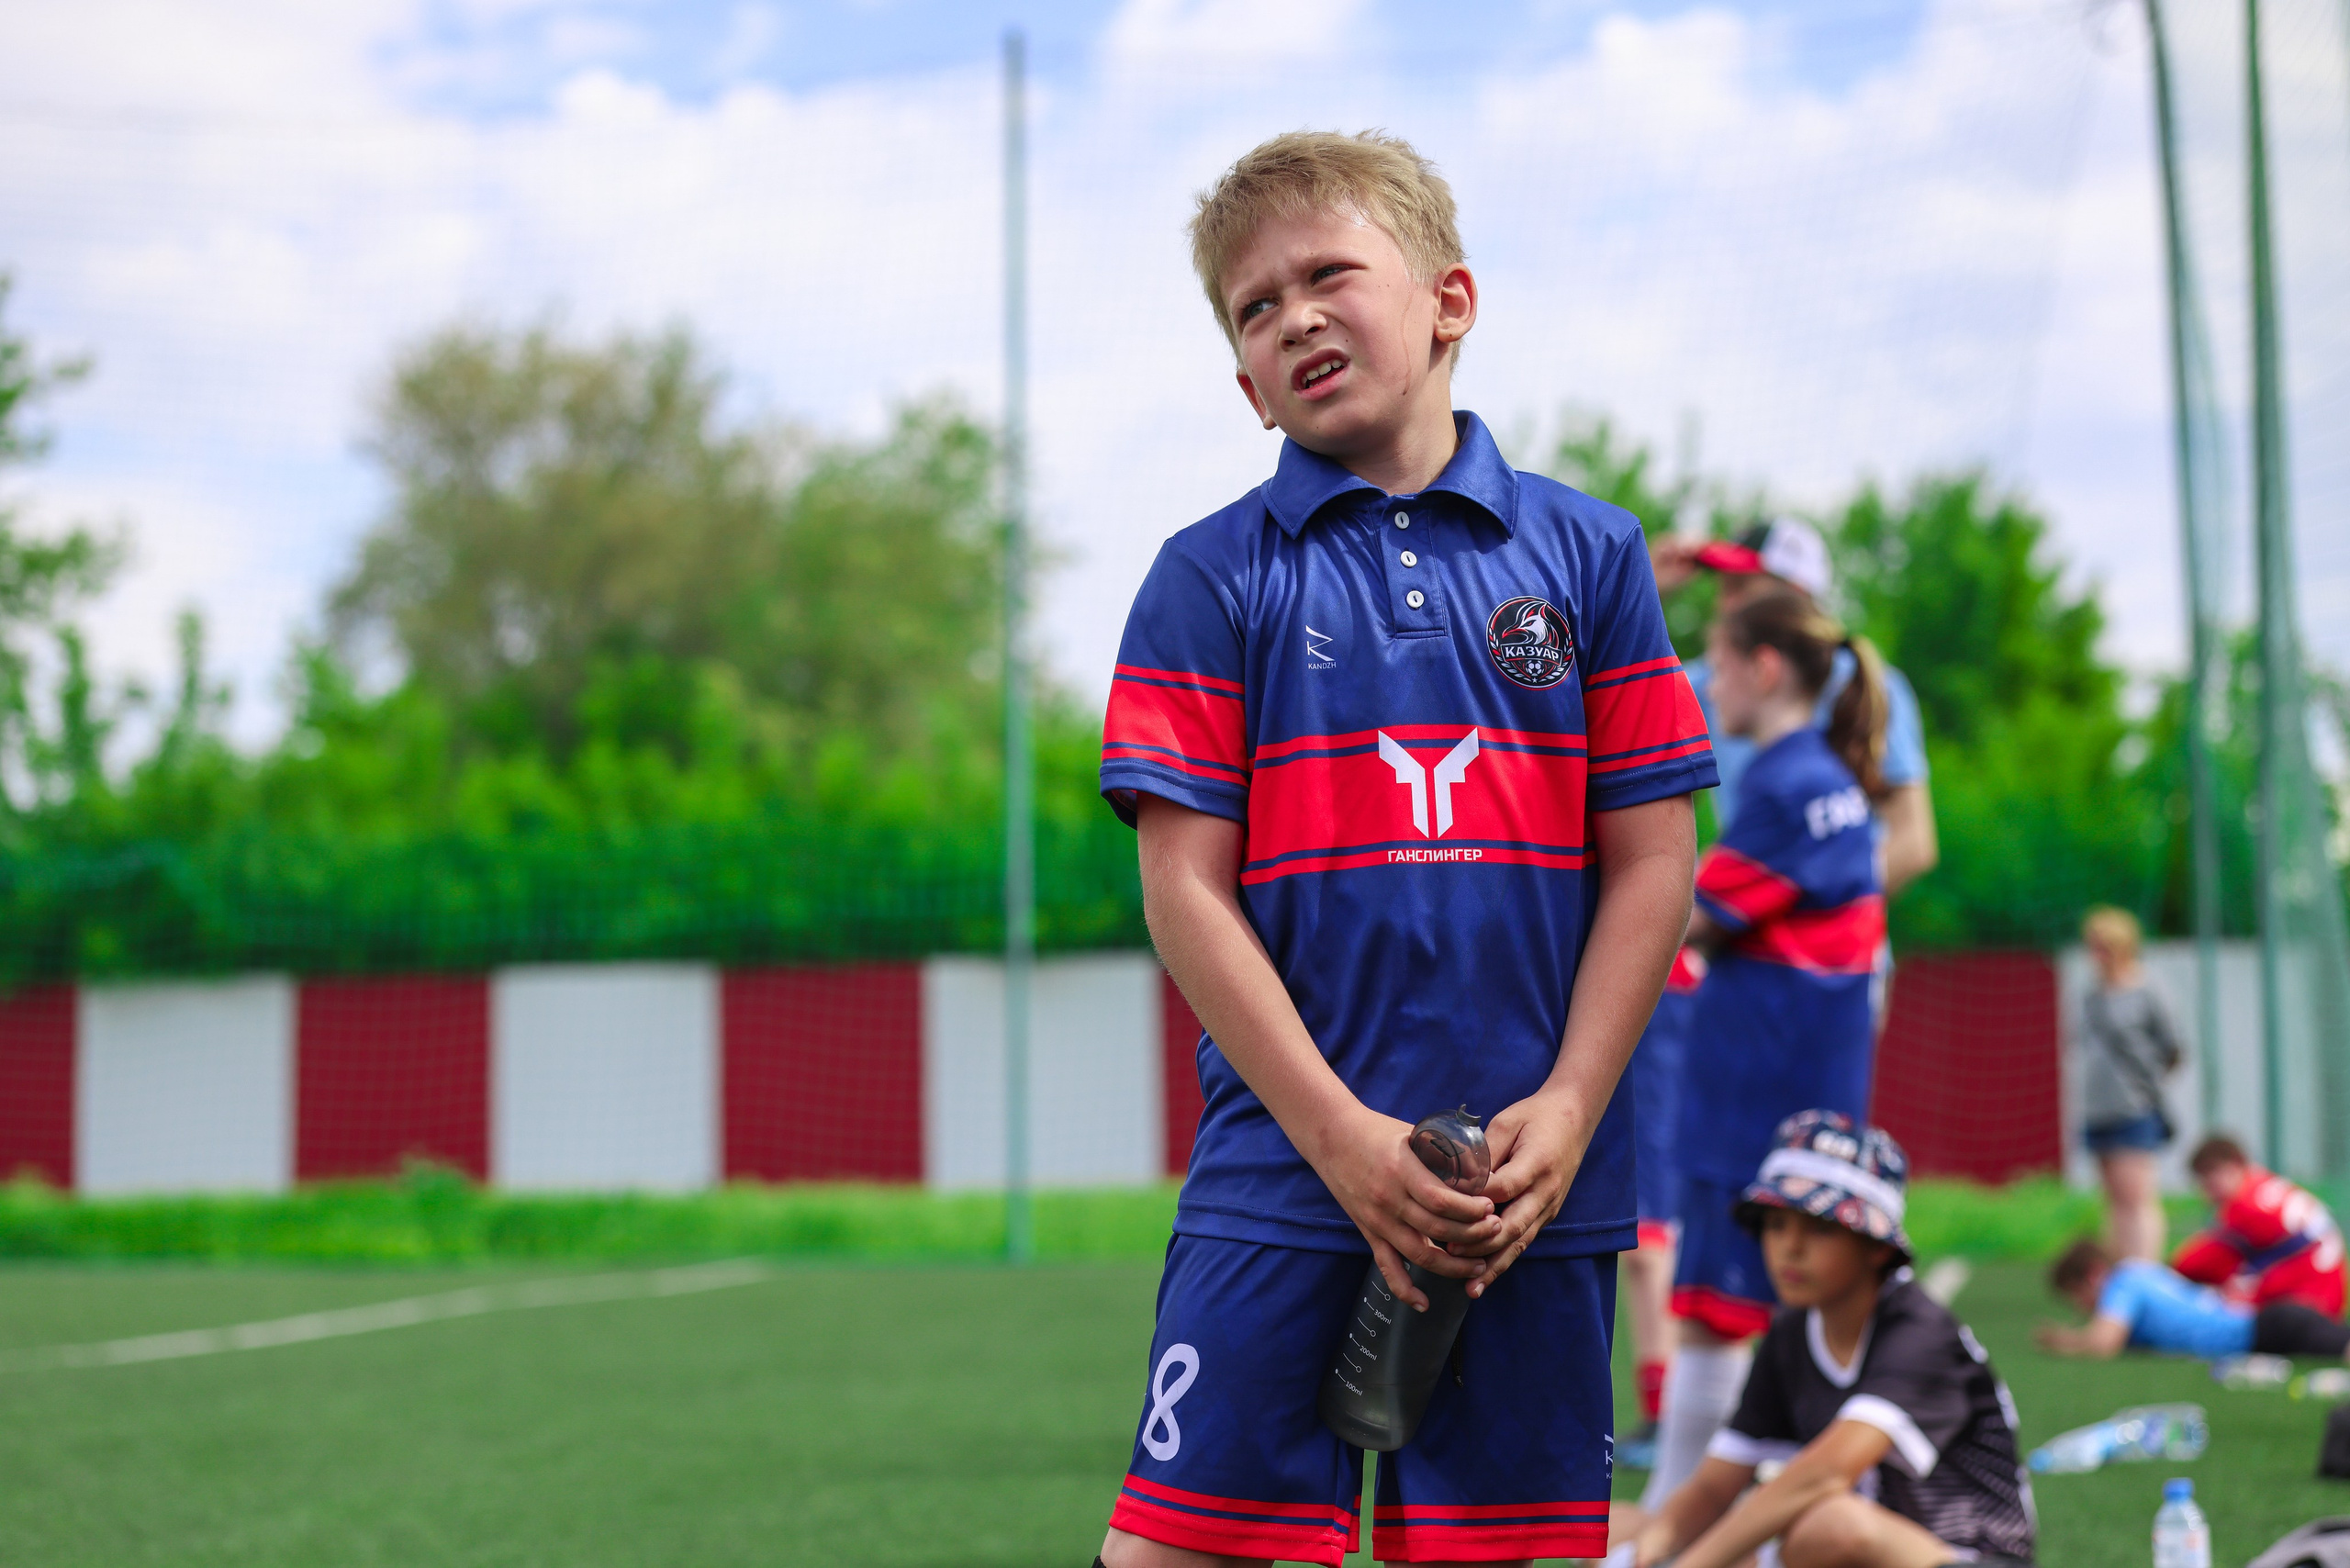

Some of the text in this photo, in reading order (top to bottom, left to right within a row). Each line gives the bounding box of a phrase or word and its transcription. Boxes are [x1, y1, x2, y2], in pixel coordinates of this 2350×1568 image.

[1505, 645, 1559, 661] КАЗУАР
[1308, 662, 1337, 670] KANDZH
[1387, 848, 1483, 862] ГАНСЛИНГЕР
[1373, 1308, 1393, 1325] 300ml
[1360, 1345, 1378, 1361] 200ml
[1345, 1381, 1363, 1396] 100ml
[1142, 1342, 1201, 1462] 8
